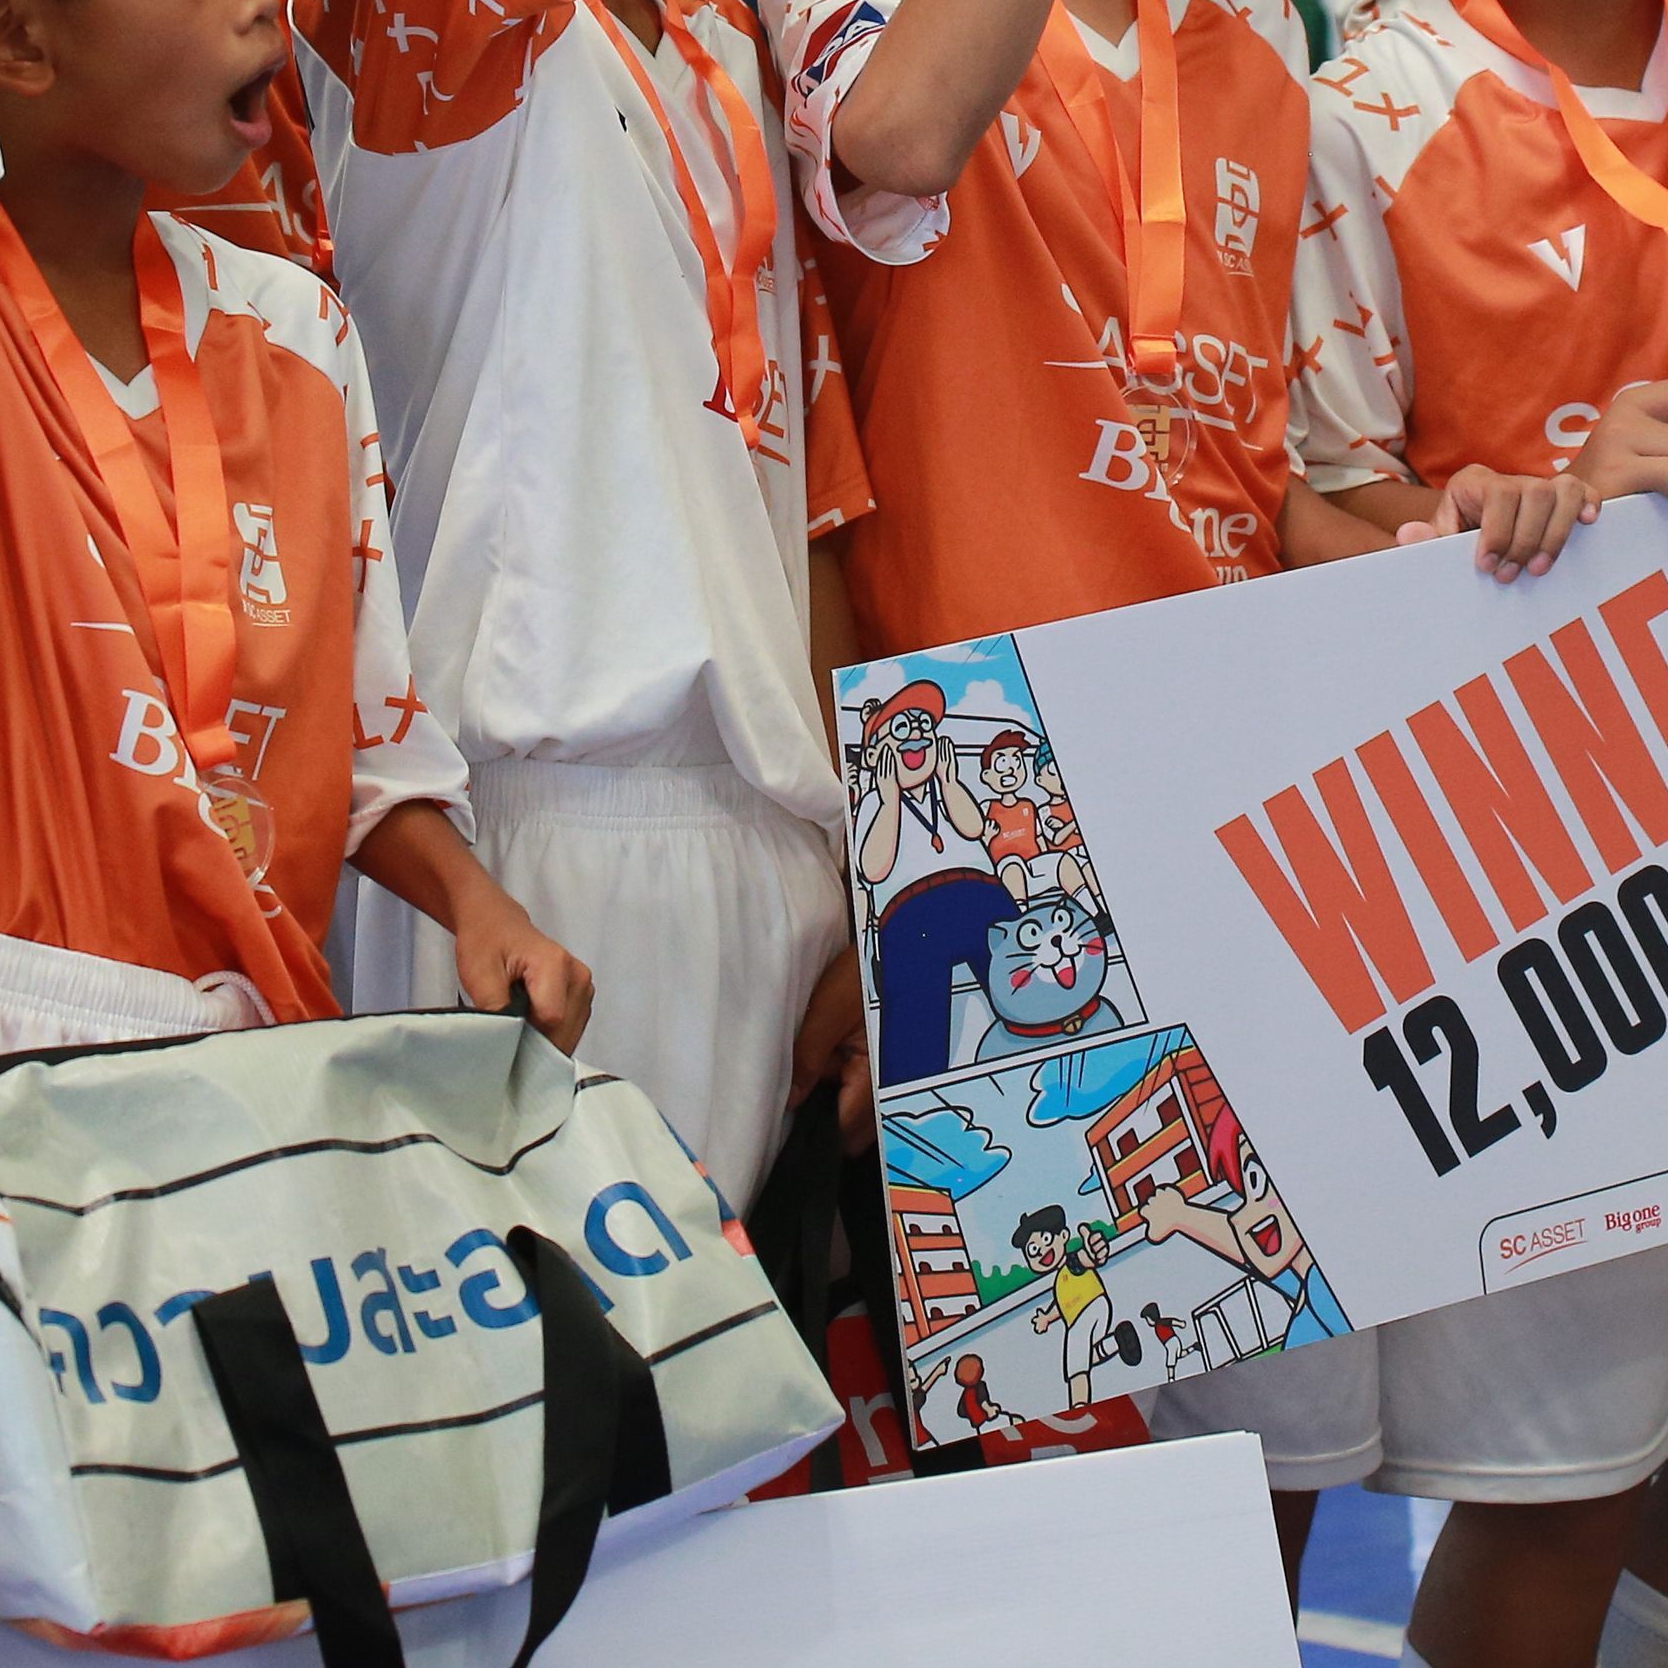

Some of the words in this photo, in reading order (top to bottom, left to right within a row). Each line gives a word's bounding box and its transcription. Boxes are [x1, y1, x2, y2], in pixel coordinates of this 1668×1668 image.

[1189, 506, 1258, 559] ne
[1500, 1234, 1527, 1260] SC
[1529, 1217, 1586, 1253] ASSET
[1635, 1217, 1662, 1234] group
